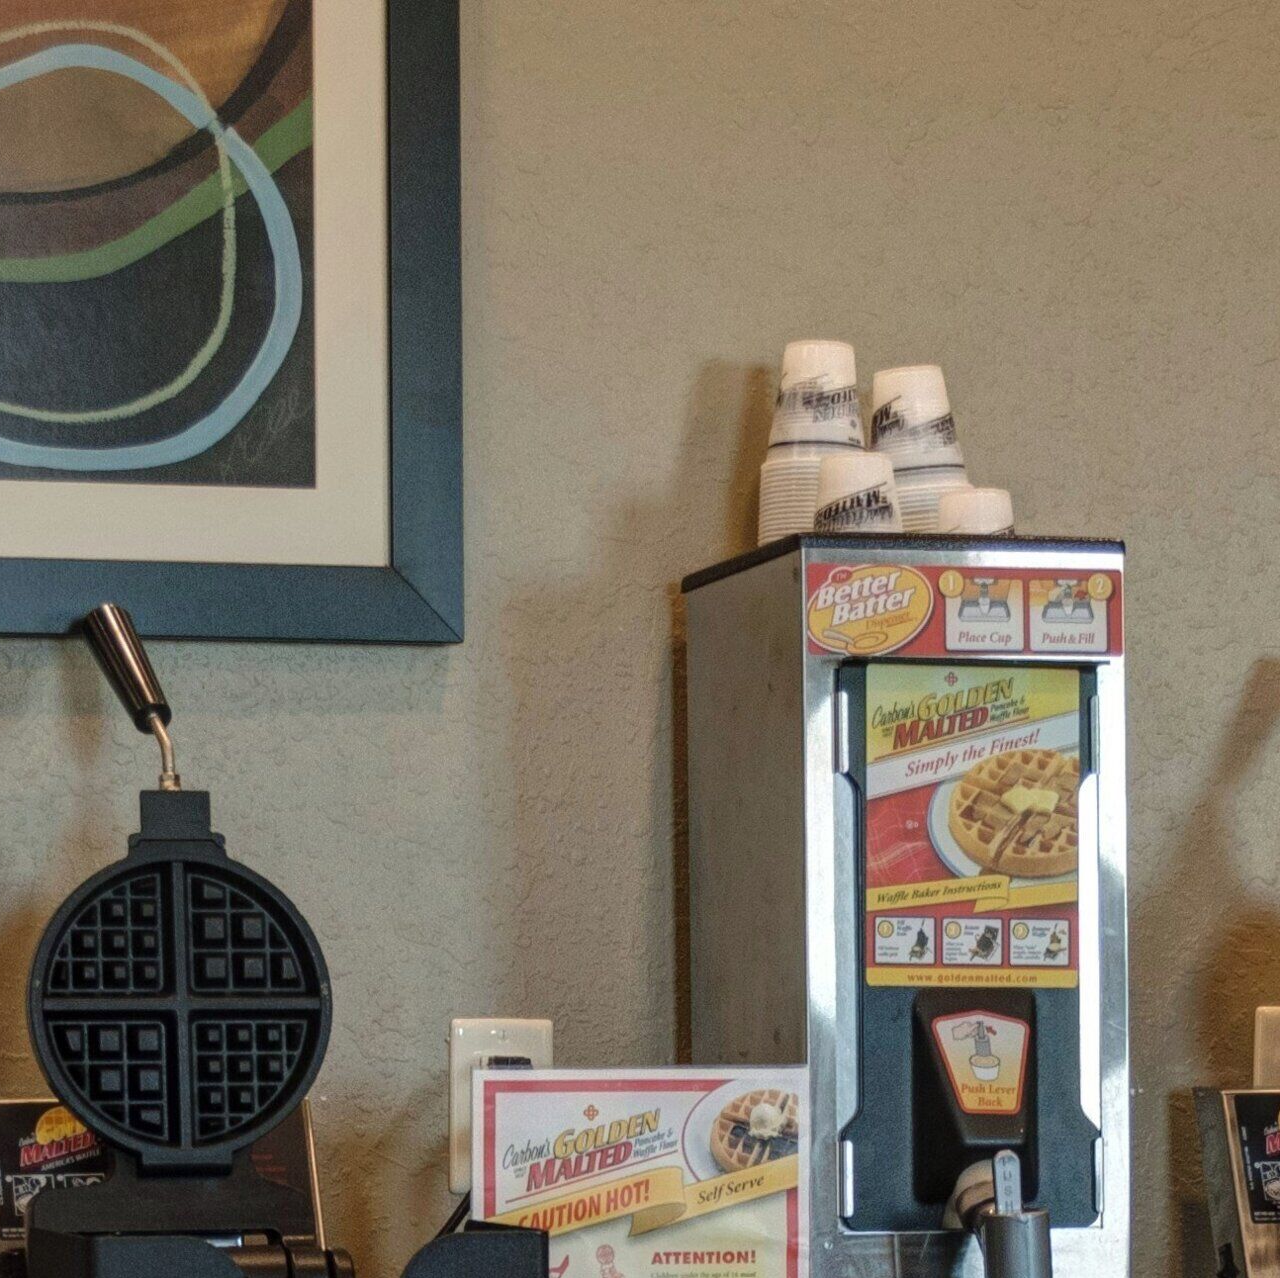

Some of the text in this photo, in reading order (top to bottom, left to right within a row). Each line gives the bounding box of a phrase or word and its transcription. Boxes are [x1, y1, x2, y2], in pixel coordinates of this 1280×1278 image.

[816, 571, 902, 611] Better
[948, 575, 954, 591] 1
[1095, 579, 1104, 594] 2
[832, 587, 915, 627] Batter
[958, 631, 1012, 646] Place Cup
[1042, 632, 1067, 644] Push
[1078, 632, 1096, 644] Fill
[917, 677, 1015, 721] GOLDEN
[893, 706, 989, 750] MALTED
[905, 728, 1040, 777] Simply the Finest!
[877, 881, 1002, 903] Waffle Baker Instructions
[961, 1083, 1016, 1095] Push Lever
[977, 1096, 1002, 1107] Back
[503, 1108, 661, 1169] Carbon's GOLDEN
[526, 1141, 633, 1192] MALTED
[606, 1179, 650, 1213] HOT!
[697, 1176, 764, 1205] Self Serve
[651, 1250, 757, 1265] ATTENTION!
